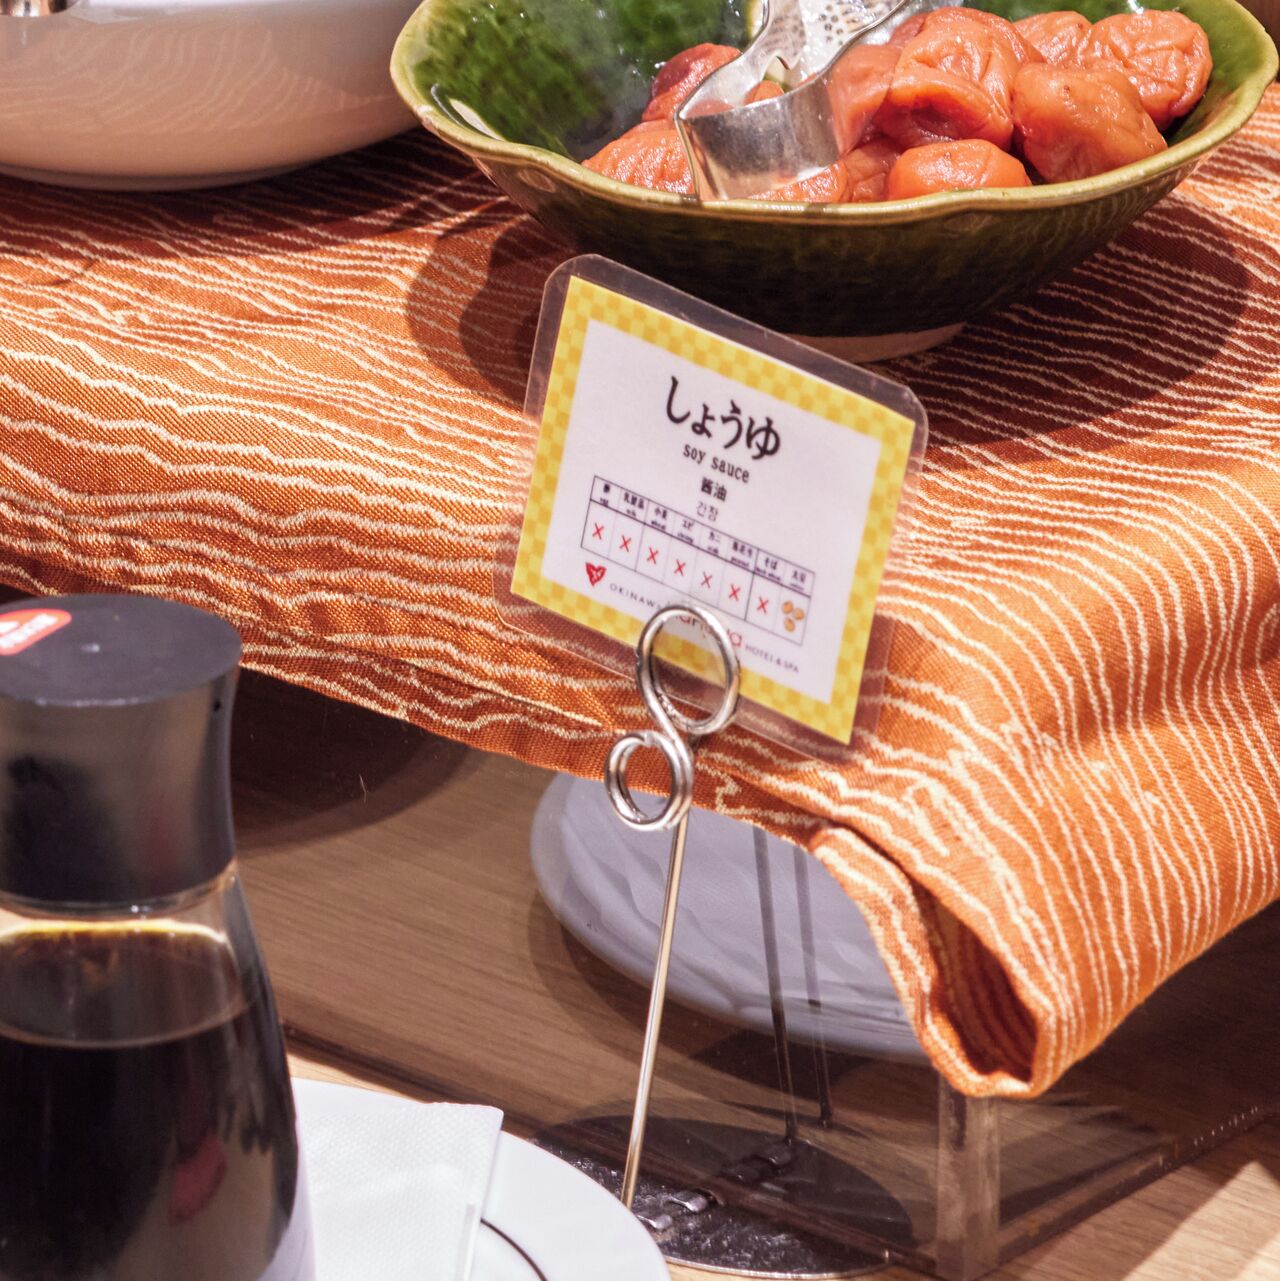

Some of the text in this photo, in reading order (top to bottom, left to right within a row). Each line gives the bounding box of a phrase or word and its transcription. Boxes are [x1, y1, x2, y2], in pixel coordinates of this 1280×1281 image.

[665, 375, 781, 461] しょうゆ
[682, 443, 750, 484] soy sauce
[696, 501, 719, 523] 간장
[744, 643, 773, 662] HOTEL
[783, 660, 799, 673] SPA
